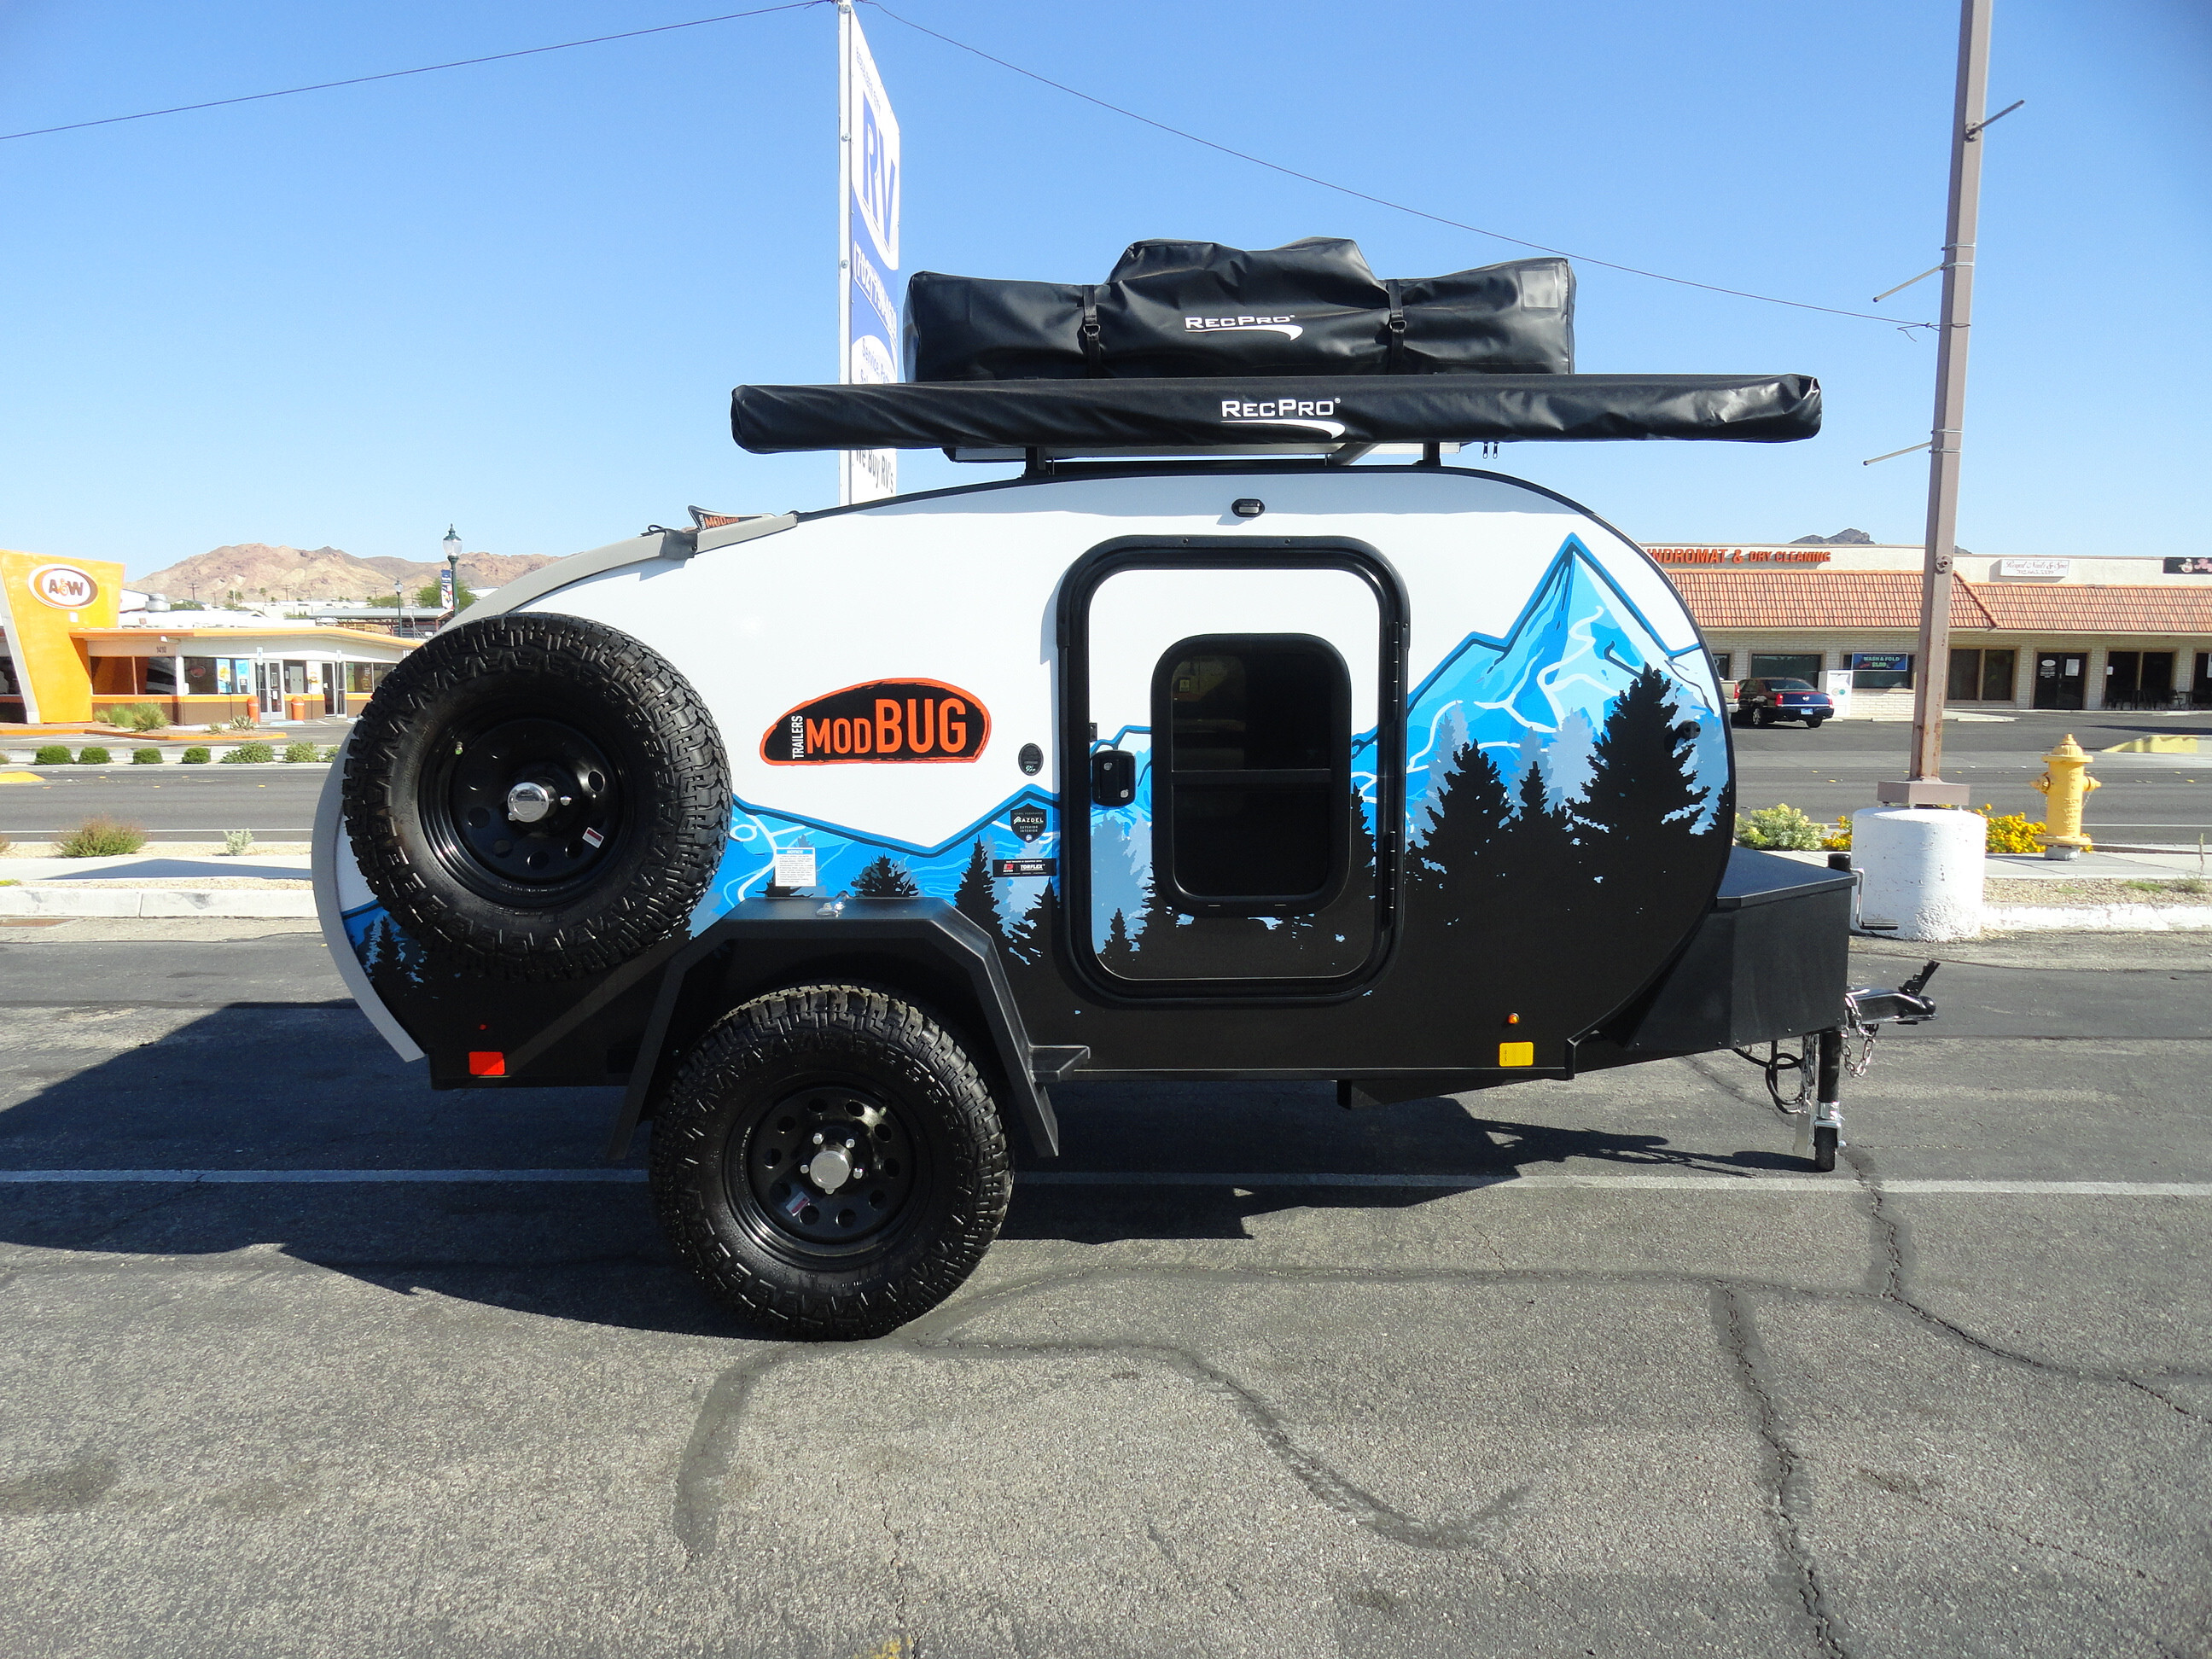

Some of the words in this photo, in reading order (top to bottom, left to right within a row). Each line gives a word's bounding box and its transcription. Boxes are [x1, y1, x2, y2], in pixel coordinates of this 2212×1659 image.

[863, 90, 896, 248] RV
[1646, 548, 1728, 564] NDROMAT
[1732, 549, 1744, 564] &
[1749, 550, 1772, 562] DRY
[1775, 550, 1831, 562] CLEANING
[49, 578, 84, 596] A&W
[791, 715, 804, 759] TRAILERS
